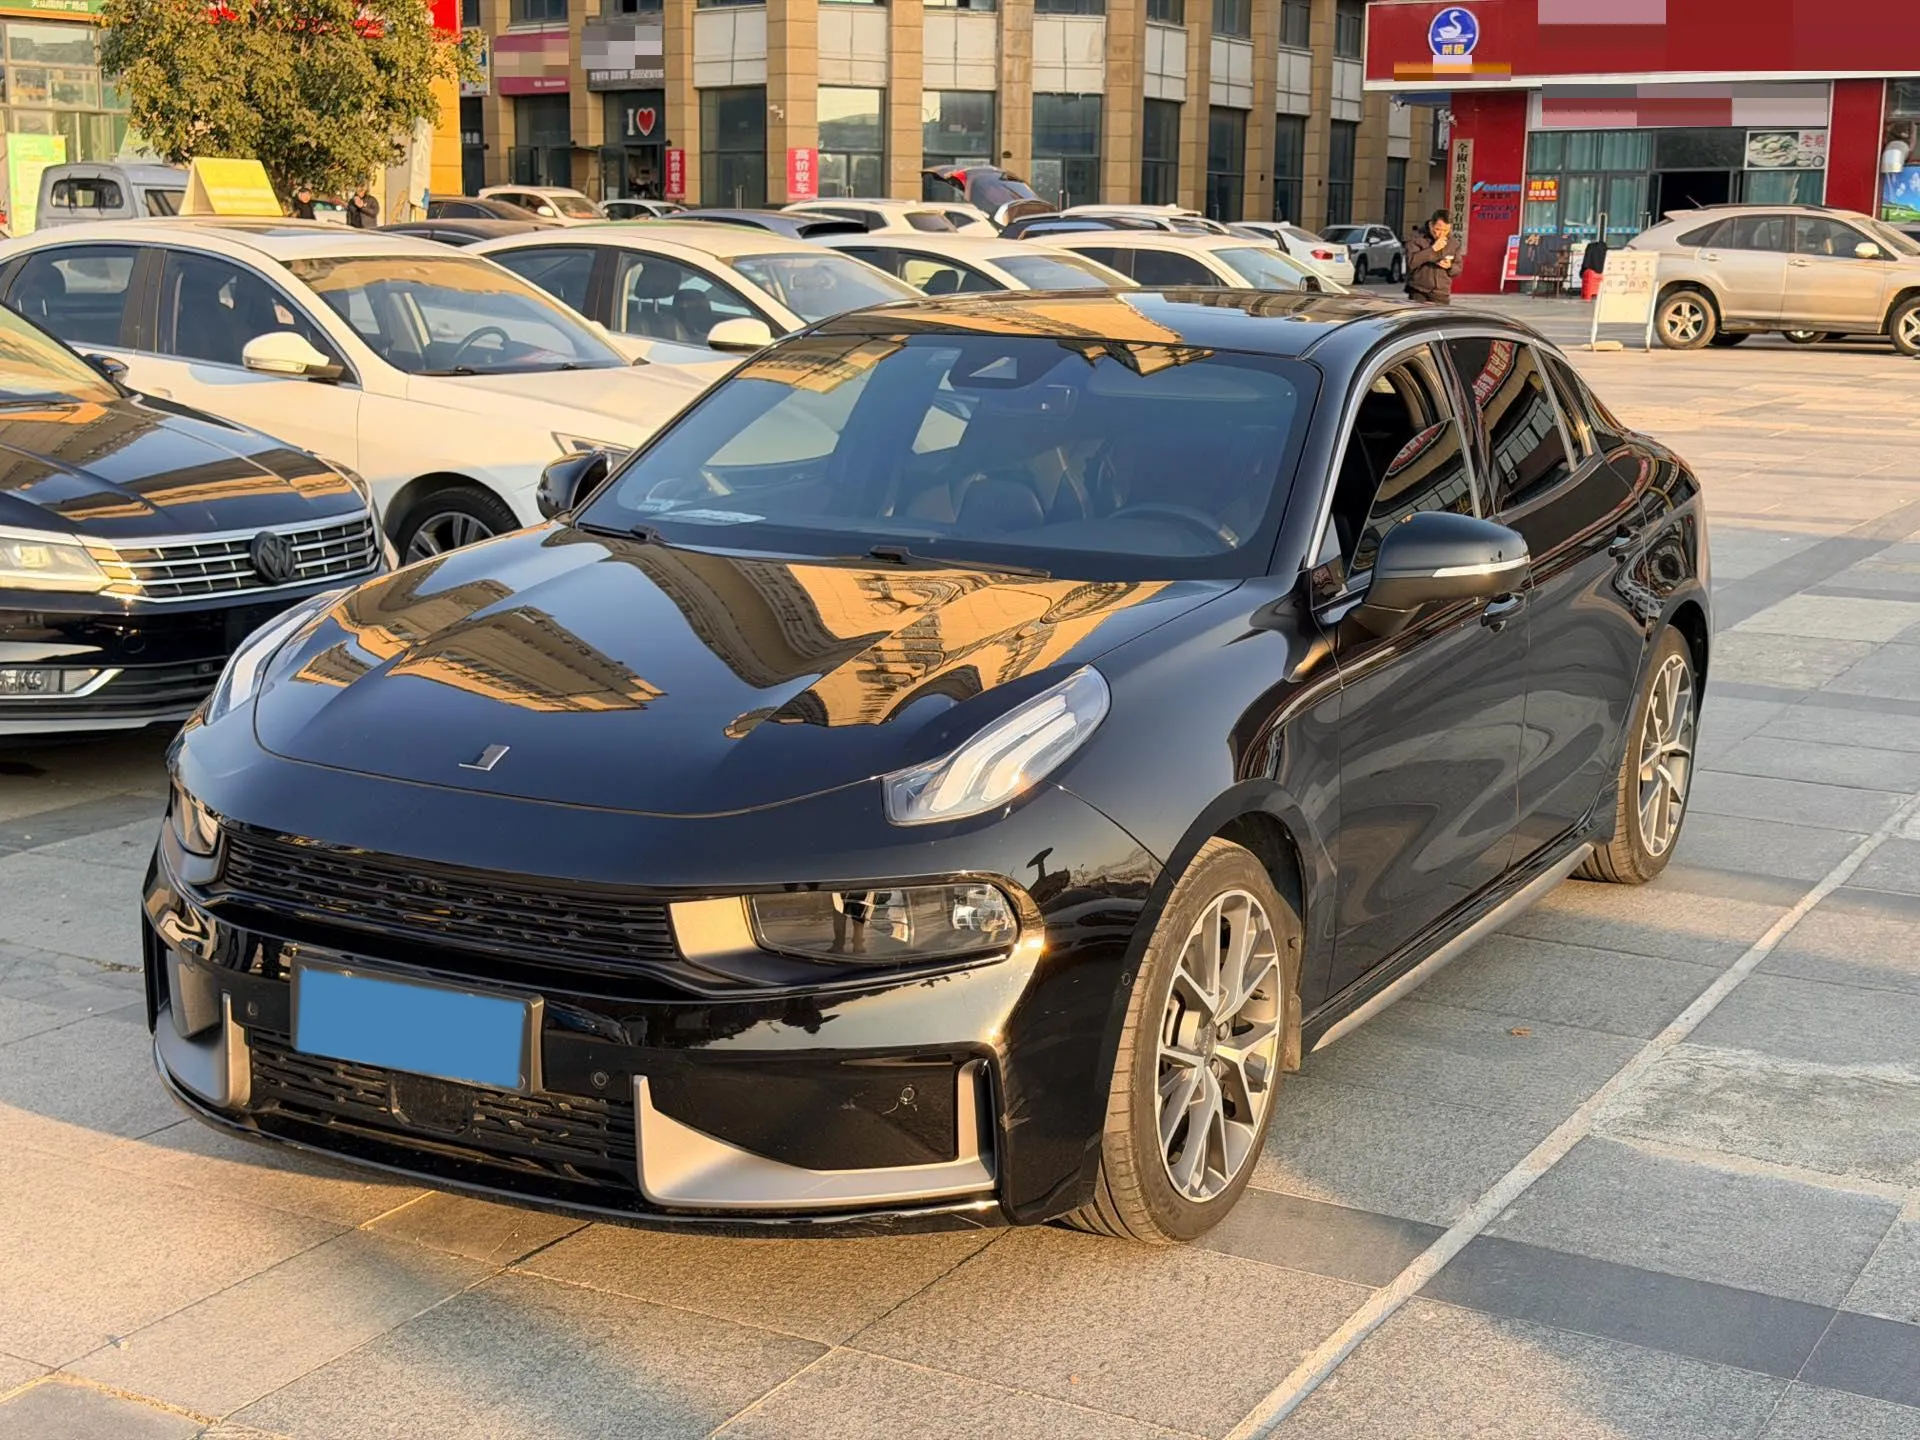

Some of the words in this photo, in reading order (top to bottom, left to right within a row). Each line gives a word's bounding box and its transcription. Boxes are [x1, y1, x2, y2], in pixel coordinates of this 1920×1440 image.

[670, 151, 681, 193] 高价收车
[795, 149, 810, 194] 高价收车
